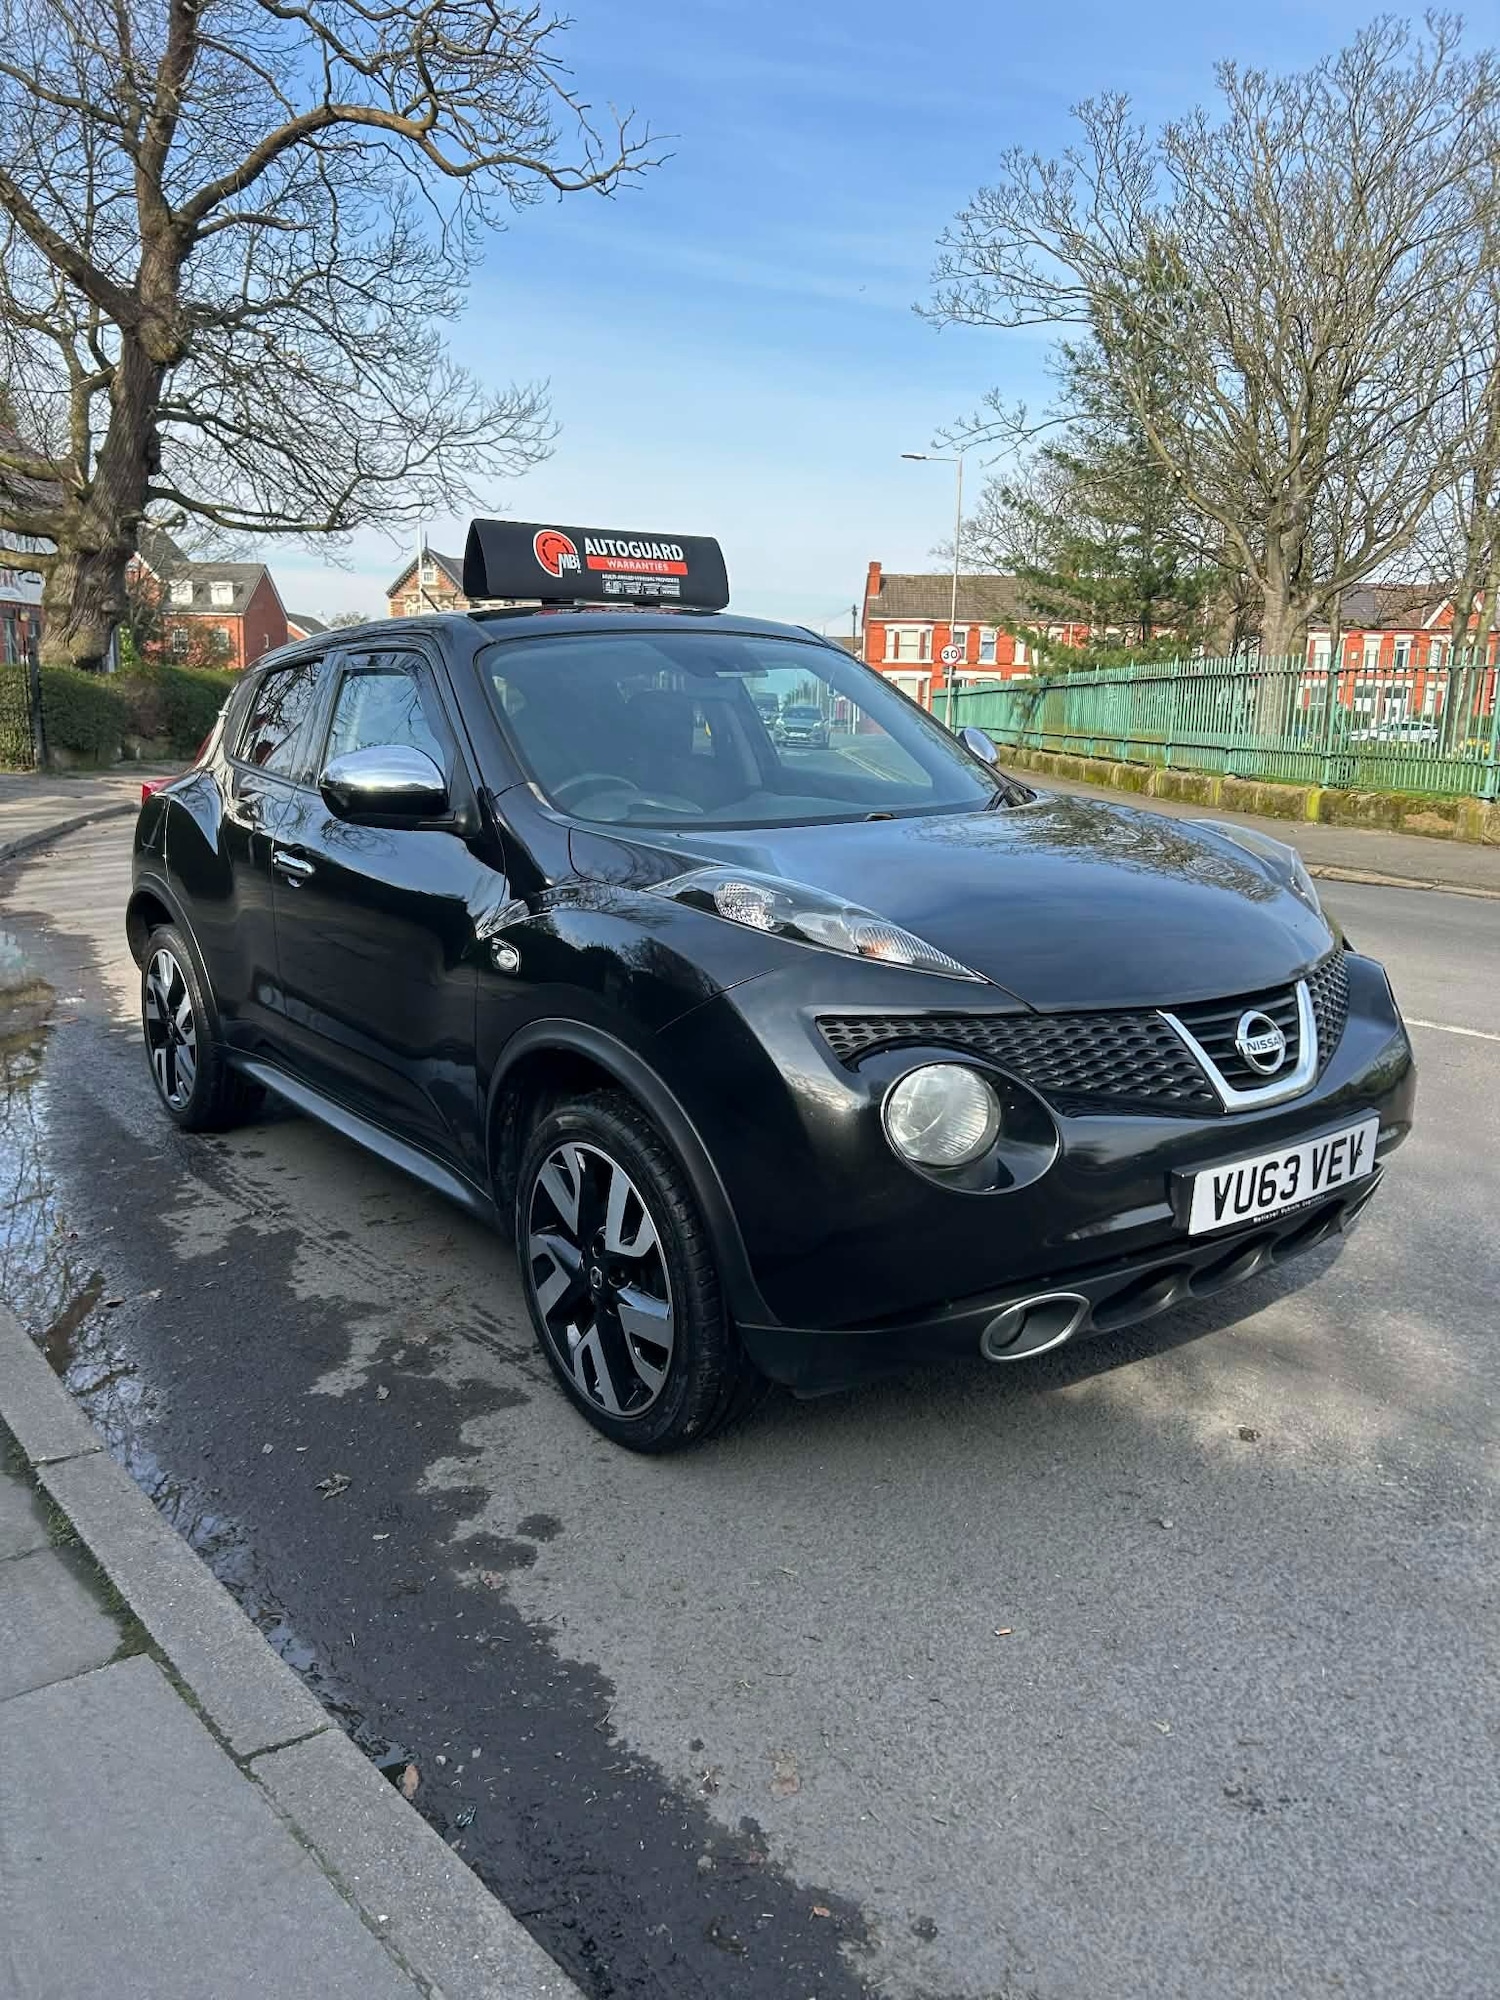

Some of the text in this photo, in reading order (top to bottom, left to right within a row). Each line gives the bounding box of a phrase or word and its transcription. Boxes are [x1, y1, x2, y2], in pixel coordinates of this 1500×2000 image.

[585, 537, 684, 561] AUTOGUARD
[607, 559, 669, 571] WARRANTIES
[943, 650, 957, 659] 30
[1246, 1033, 1284, 1051] NISSAN
[1213, 1130, 1366, 1221] VU63 VEV
